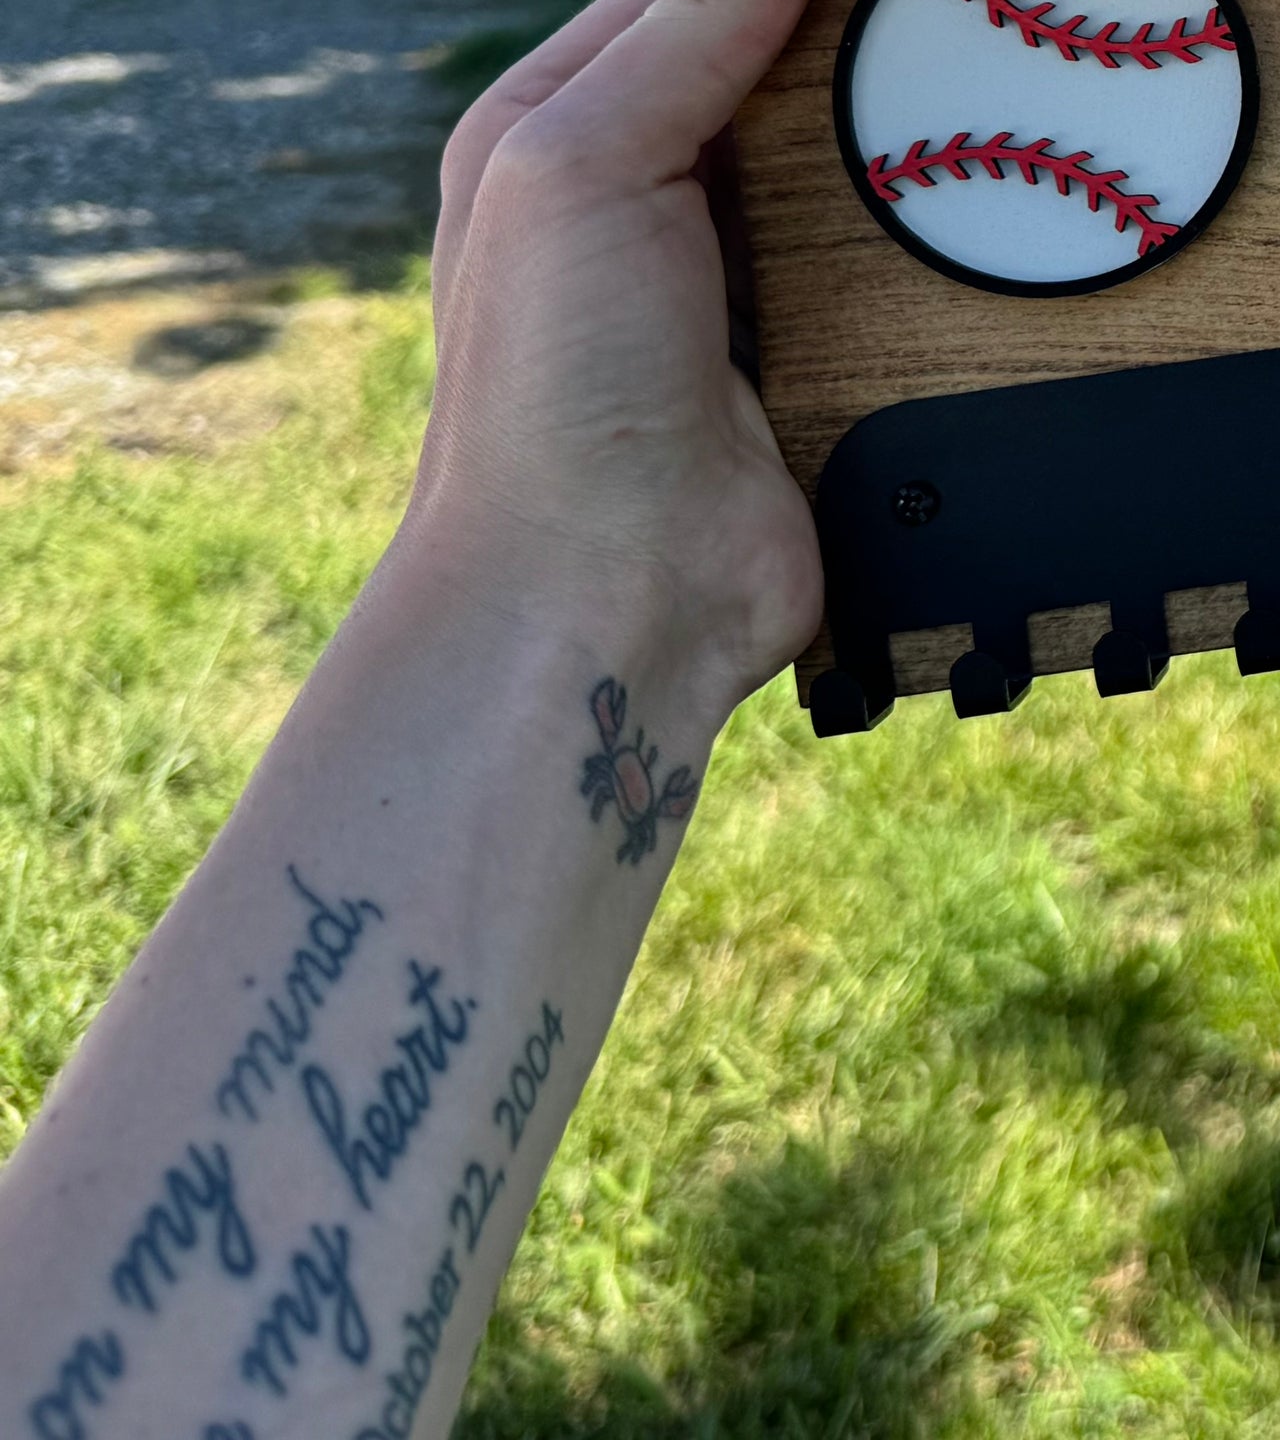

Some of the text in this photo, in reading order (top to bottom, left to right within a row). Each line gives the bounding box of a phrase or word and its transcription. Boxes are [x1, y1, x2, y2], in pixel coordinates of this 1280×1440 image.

[111, 1143, 257, 1315] my
[216, 863, 384, 1125] mind,
[240, 959, 480, 1398] my heart.
[353, 999, 565, 1440] ctober 22, 2004
